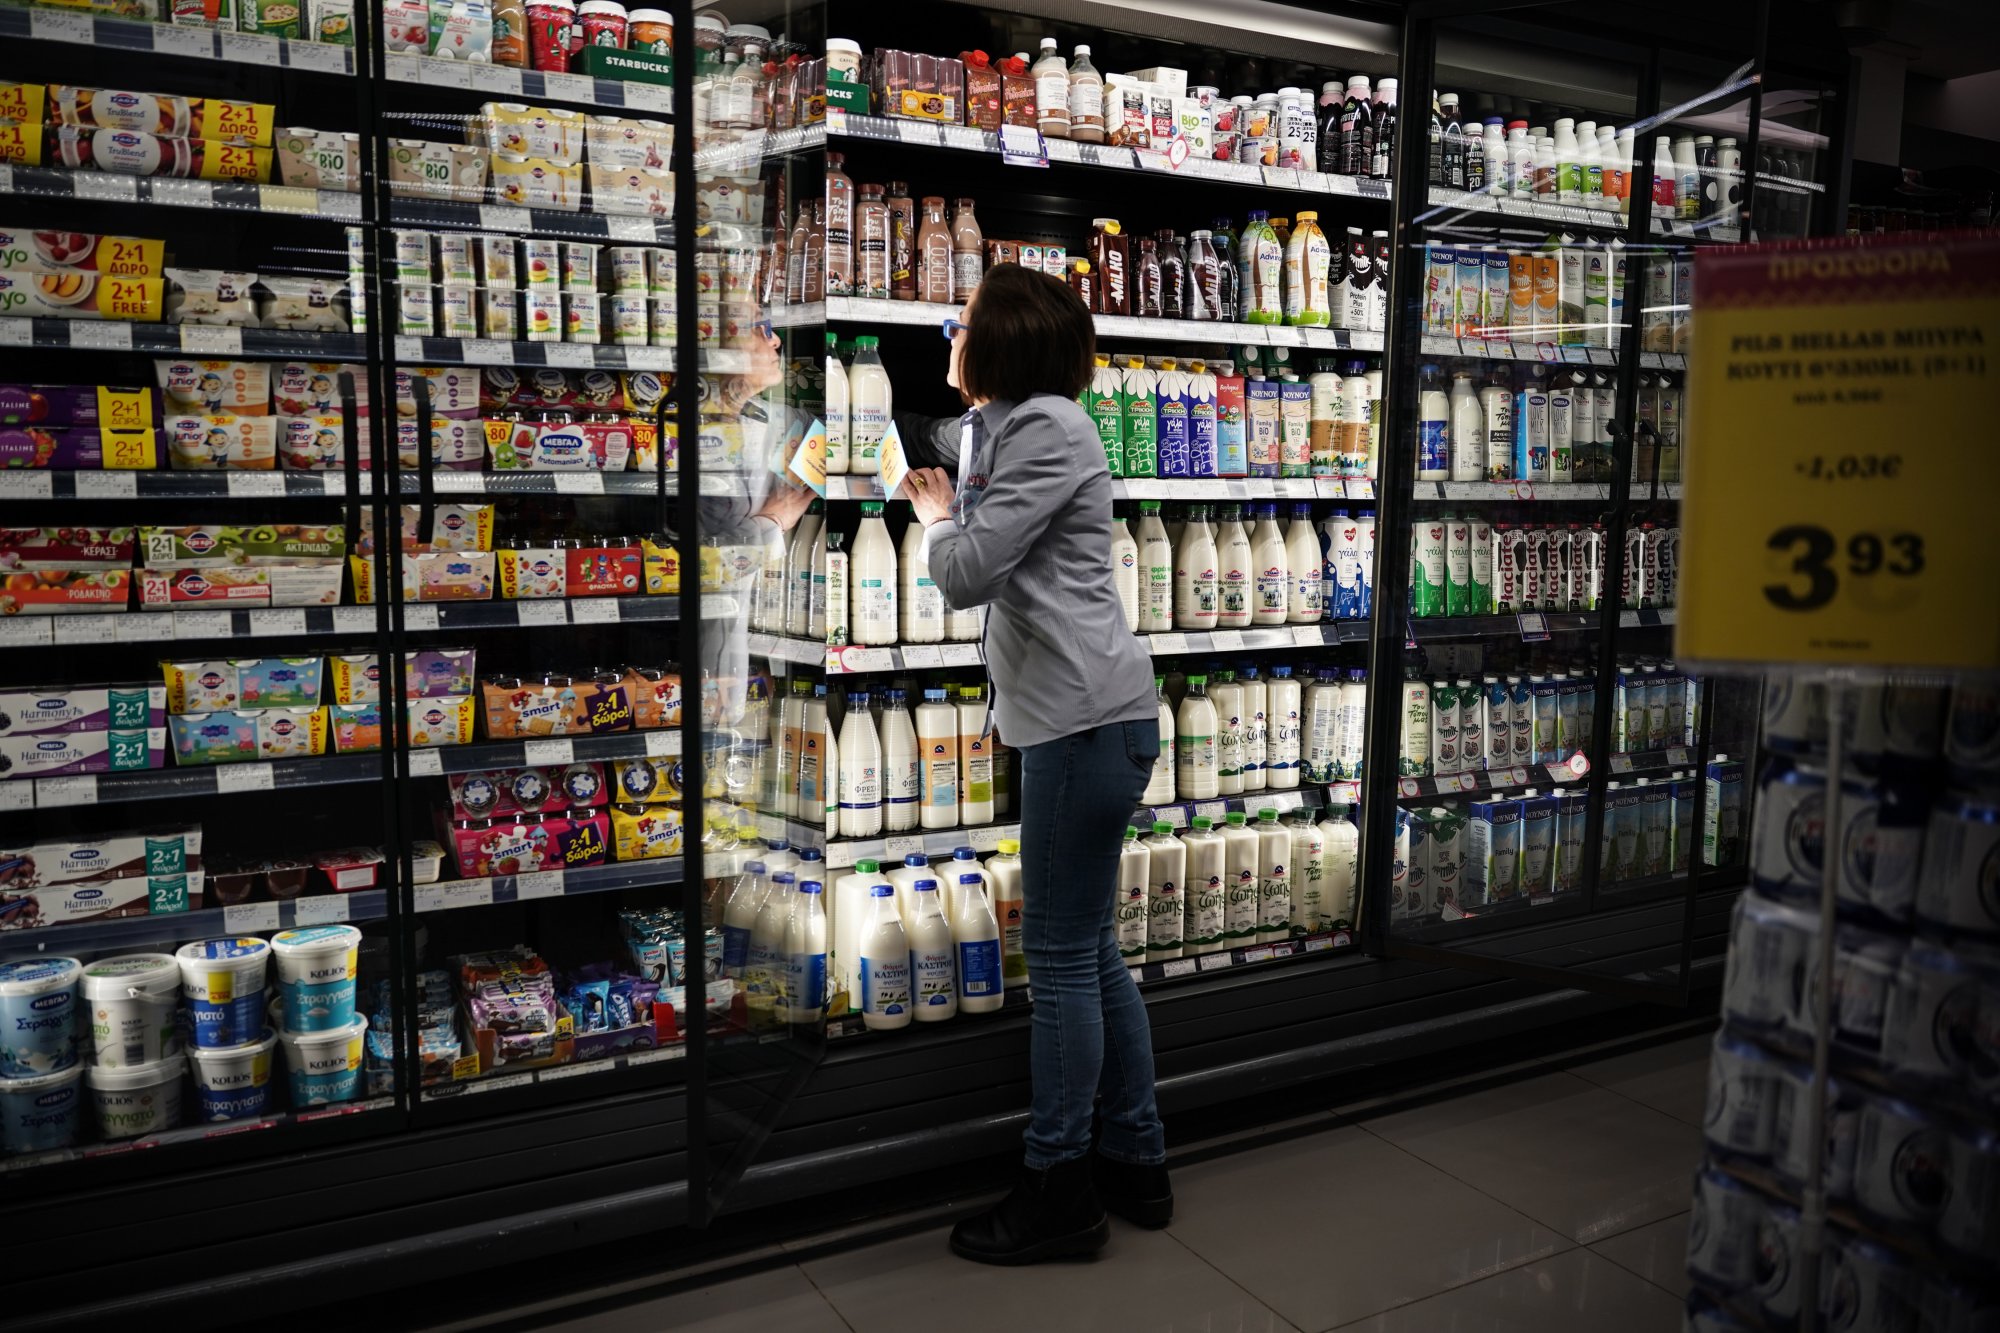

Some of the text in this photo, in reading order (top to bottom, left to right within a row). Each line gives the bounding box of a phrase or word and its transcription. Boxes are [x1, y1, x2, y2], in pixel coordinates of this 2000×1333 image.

[605, 56, 670, 74] STARBUCKS
[106, 107, 146, 118] TruBlend
[219, 105, 257, 124] 2+1
[218, 123, 258, 135] ΔΩΡΟ
[1288, 126, 1301, 139] 25
[1303, 131, 1315, 143] 25
[107, 146, 147, 158] TruBlend
[220, 147, 257, 166] 2+1
[218, 165, 258, 178] ΔΩΡΟ
[112, 243, 144, 262] 2+1
[1457, 256, 1481, 266] ΝΟΥΝΟΥ
[1486, 258, 1509, 267] ΝΟΥΝΟΥ
[1768, 249, 1951, 281] ΠΡΟΣΦΟΡΑ
[110, 262, 149, 276] ΔΩΡΟ
[931, 247, 948, 294] CHOCO
[111, 282, 147, 301] 2+1
[112, 301, 148, 315] FREE
[1349, 296, 1367, 306] Protein
[1352, 303, 1364, 313] Plus
[1790, 330, 1884, 350] HELLAS
[1251, 389, 1279, 399] ΝΟΥΝΟΥ
[1283, 390, 1310, 400] ΝΟΥΝΟΥ
[112, 400, 141, 418] 2+1
[1530, 406, 1545, 421] LOVE
[1553, 408, 1567, 422] LOVE
[1255, 419, 1273, 429] Family
[1287, 420, 1305, 429] Family
[1530, 420, 1545, 434] MILK
[1553, 420, 1568, 435] MILK
[488, 428, 507, 440] -80
[543, 437, 581, 447] ΜΕΒΓΑΛ
[115, 442, 144, 457] 2+1
[537, 456, 585, 466] frutomaniacs
[151, 536, 173, 553] 2+1
[1763, 525, 1926, 612] 3 93
[146, 579, 168, 595] 2+1
[20, 708, 72, 721] Harmony
[114, 702, 145, 717] 2+1
[522, 701, 560, 718] smart
[21, 749, 73, 762] Harmony
[114, 743, 145, 758] 2+1
[1525, 808, 1552, 819] ΝΟΥΝΟΥ
[1560, 804, 1586, 815] ΝΟΥΝΟΥ
[1493, 812, 1519, 824] ΝΟΥΝΟΥ
[494, 841, 534, 861] smart
[1495, 848, 1514, 857] Family
[1527, 843, 1547, 852] Family
[152, 848, 181, 864] 2+1
[60, 858, 110, 870] Harmony
[155, 887, 183, 903] 2+1
[1230, 884, 1258, 905] ζωής
[64, 897, 114, 910] Harmony
[1151, 895, 1183, 917] ζωής
